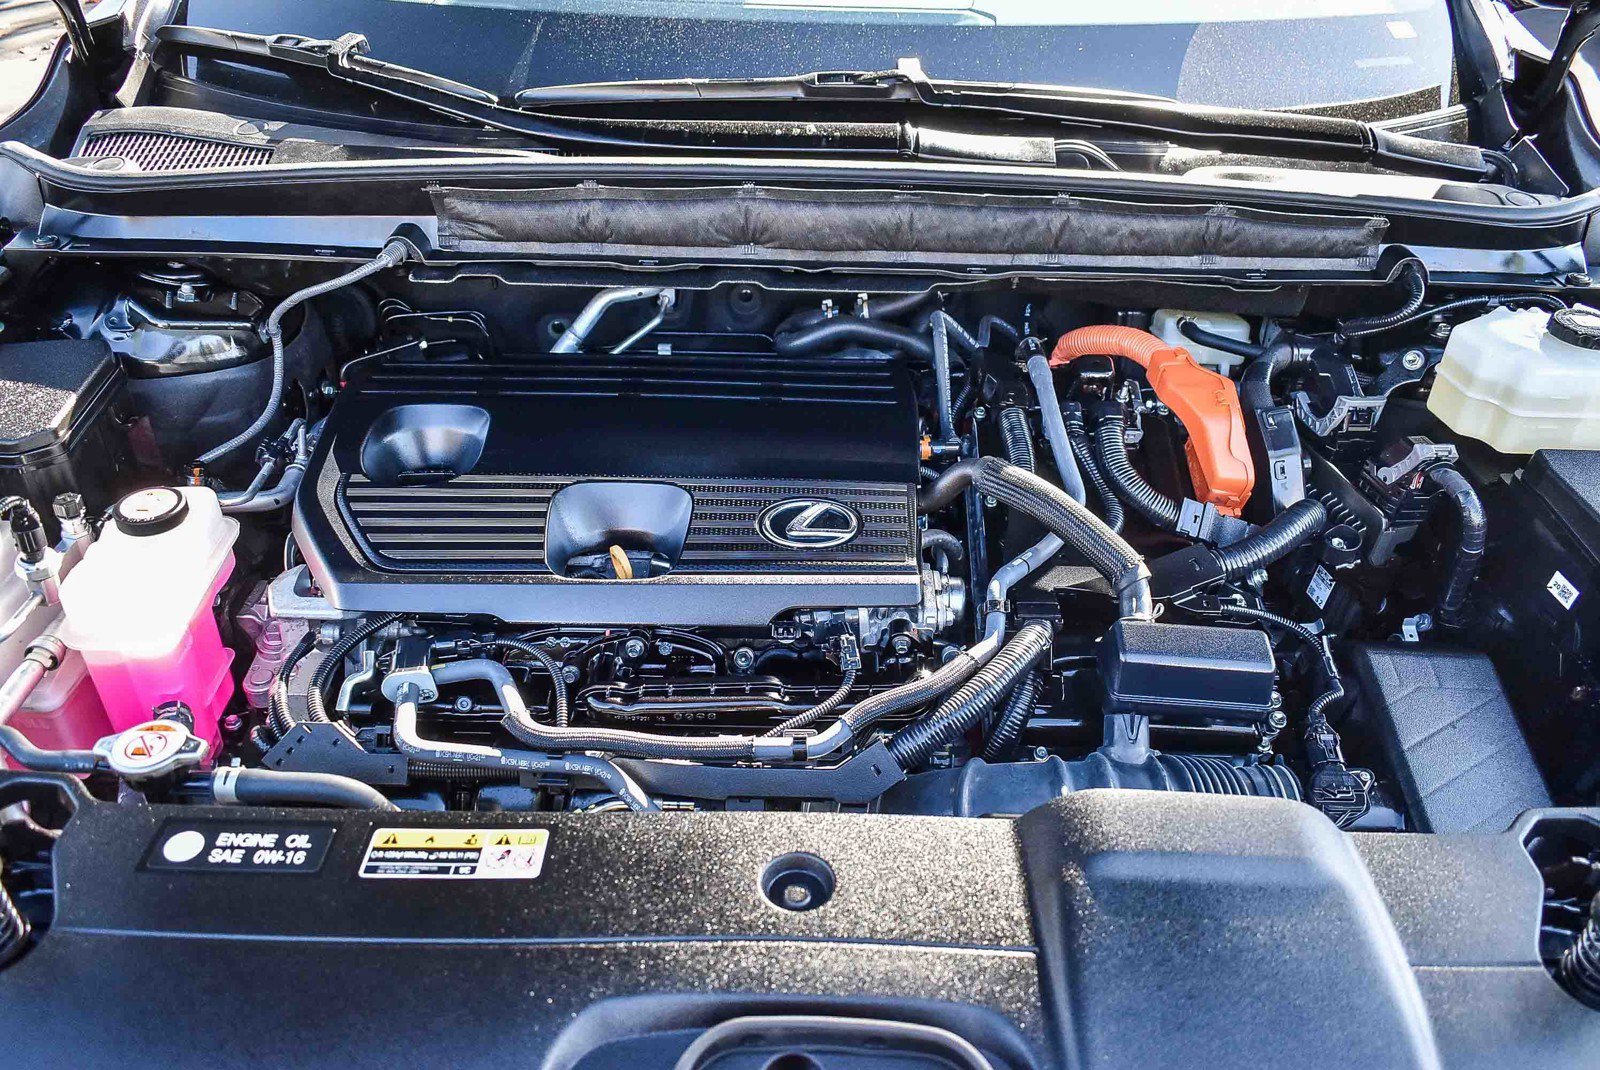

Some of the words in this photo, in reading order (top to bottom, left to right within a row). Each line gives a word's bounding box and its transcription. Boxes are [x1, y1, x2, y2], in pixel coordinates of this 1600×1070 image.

[215, 832, 279, 847] ENGINE
[285, 834, 312, 848] OIL
[208, 848, 246, 863] SAE
